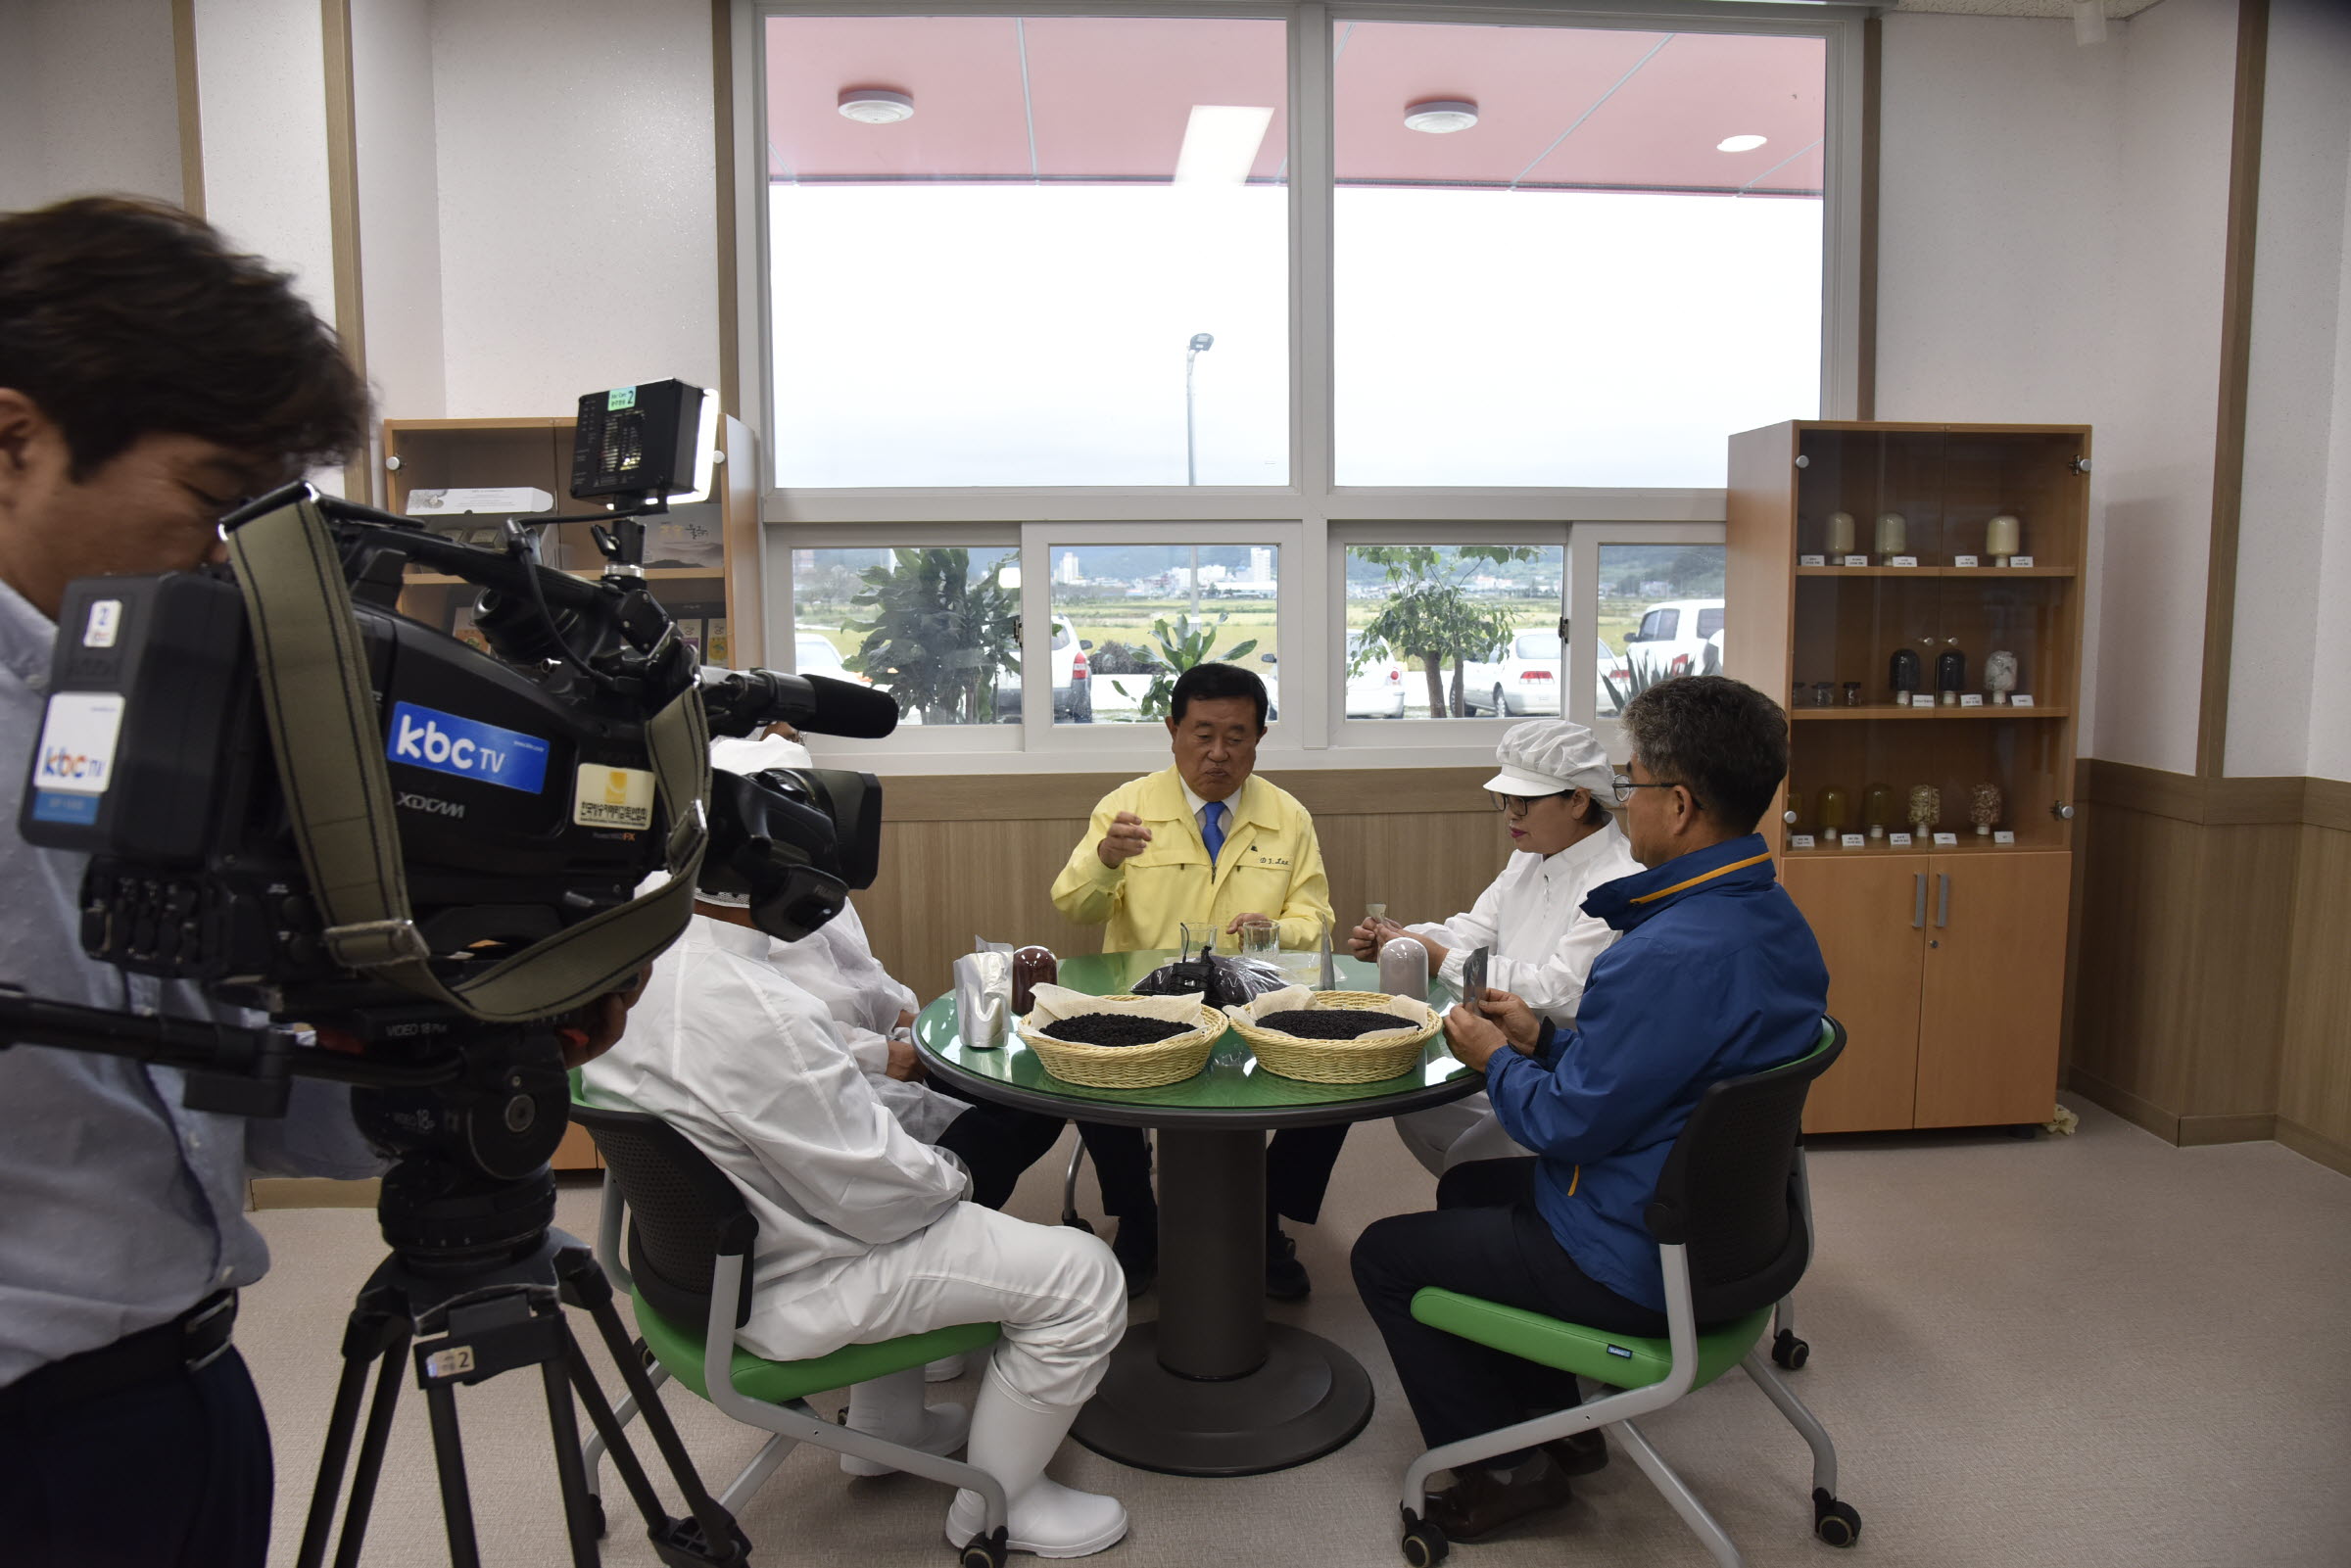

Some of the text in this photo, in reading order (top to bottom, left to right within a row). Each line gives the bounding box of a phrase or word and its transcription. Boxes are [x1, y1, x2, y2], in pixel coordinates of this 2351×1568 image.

[627, 390, 635, 404] 2
[396, 714, 506, 774] kbc TV
[42, 745, 87, 779] kbc
[397, 791, 465, 819] XDCAM
[458, 1352, 470, 1367] 2
